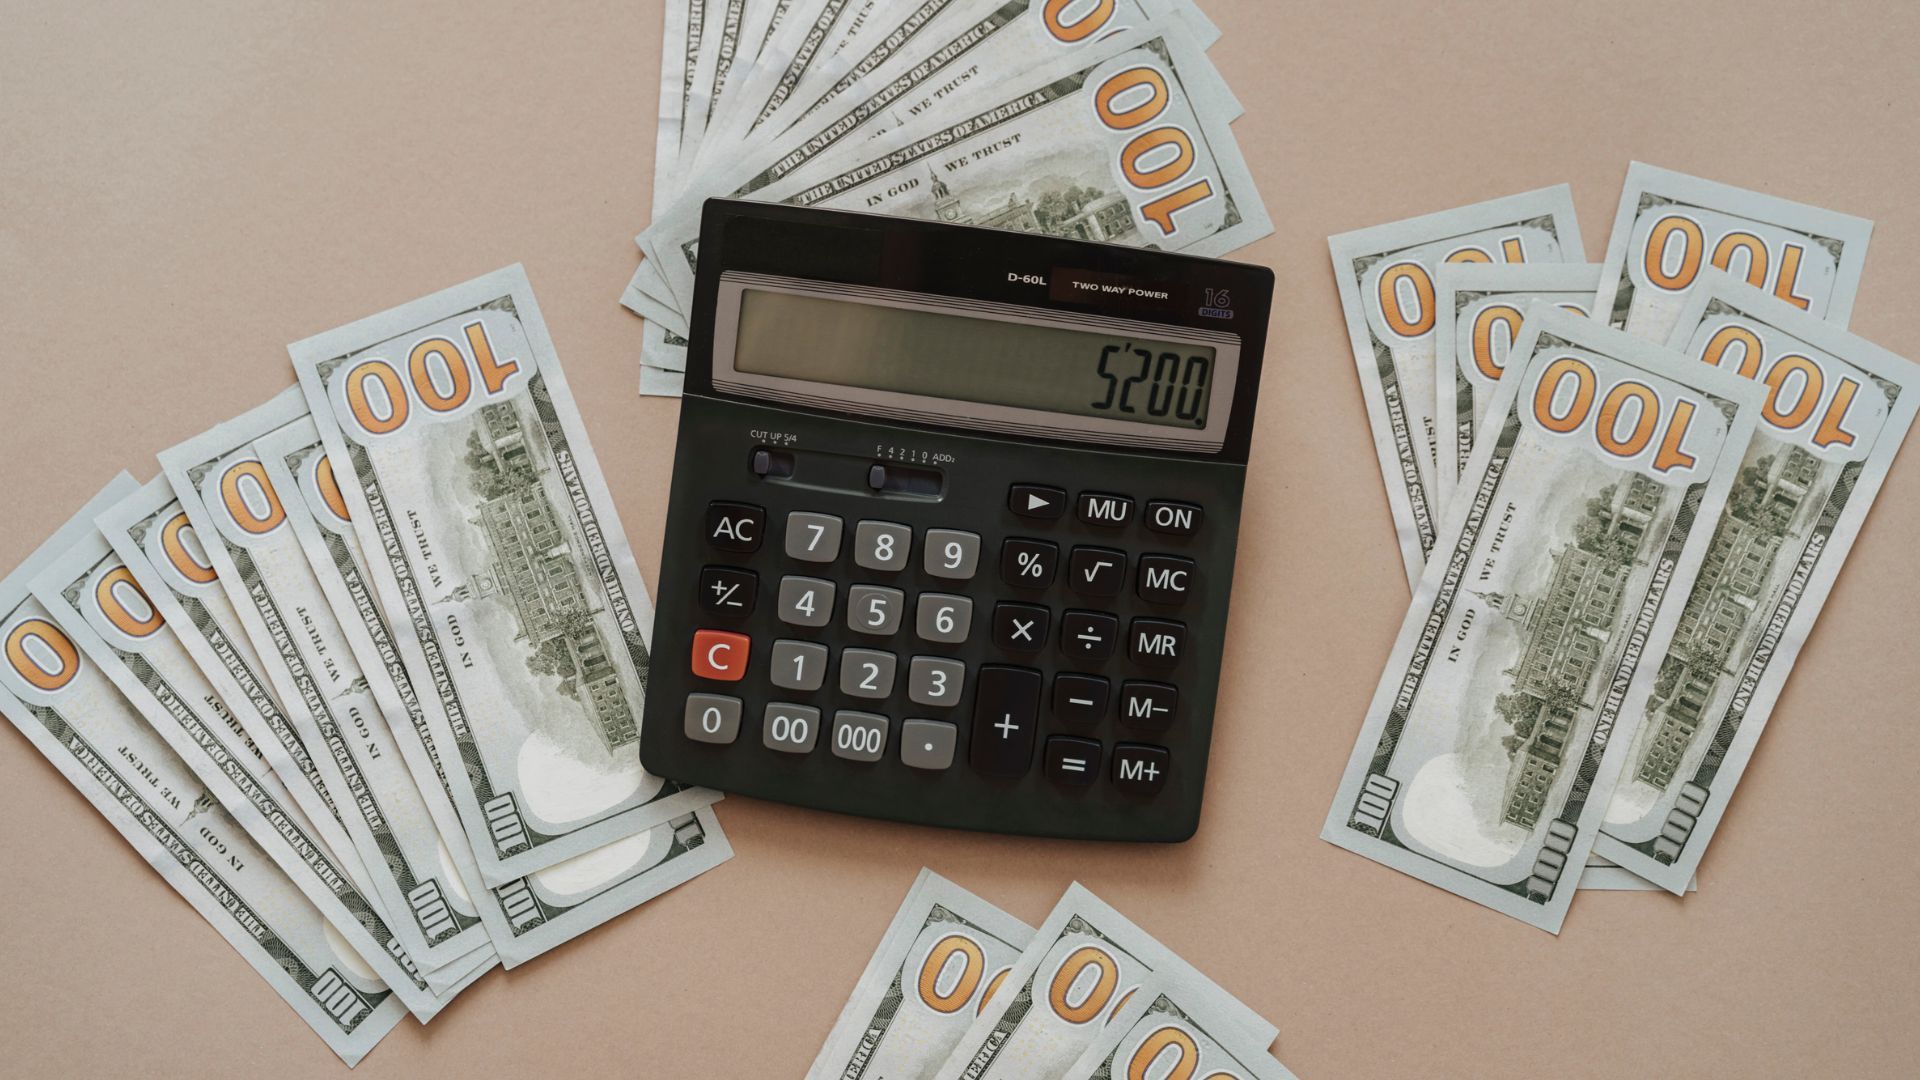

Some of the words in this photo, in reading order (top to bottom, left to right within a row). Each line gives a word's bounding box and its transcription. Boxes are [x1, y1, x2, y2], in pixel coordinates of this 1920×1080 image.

[845, 0, 875, 37] TRUS
[781, 26, 825, 87] STATES
[815, 6, 837, 31] OF
[883, 28, 907, 50] OF
[769, 148, 806, 178] THE
[801, 112, 859, 156] UNITED
[852, 74, 914, 121] STATES
[909, 61, 933, 82] OF
[926, 17, 998, 70] AMERICA
[907, 97, 933, 118] WE
[932, 63, 981, 101] TRUST
[796, 182, 833, 207] THE
[830, 155, 894, 193] UNITED
[889, 129, 953, 167] STATES
[950, 121, 974, 140] OF
[967, 88, 1048, 132] AMERICA
[1095, 66, 1214, 236] 100
[865, 192, 884, 209] IN
[886, 176, 921, 199] GOD
[943, 155, 969, 174] WE
[970, 131, 1024, 162] TRUST
[1007, 272, 1047, 286] D-60L
[1072, 281, 1099, 291] TWO
[1101, 284, 1126, 295] WAY
[1128, 288, 1169, 300] POWER
[1200, 309, 1232, 318] DIGITS
[1204, 287, 1231, 308] 16
[345, 320, 520, 435] 100
[1382, 383, 1414, 464] AMERICA
[1532, 356, 1697, 473] 100
[750, 430, 768, 440] CUT
[770, 432, 782, 441] UP
[784, 433, 797, 442] 5/4
[877, 445, 882, 453] F
[889, 446, 894, 456] 4
[900, 448, 905, 456] 2
[912, 450, 916, 458] 1
[922, 451, 928, 460] 0
[555, 449, 594, 524] DOLLARS
[1401, 461, 1419, 484] OF
[1087, 498, 1127, 521] MU
[1465, 454, 1507, 535] AMERICA
[363, 481, 402, 562] AMERICA
[404, 507, 433, 560] TRUST
[713, 516, 754, 542] AC
[1155, 506, 1193, 529] ON
[807, 524, 825, 551] 7
[874, 533, 894, 561] 8
[944, 542, 962, 569] 9
[1458, 530, 1477, 554] OF
[391, 556, 409, 580] OF
[426, 563, 444, 588] WE
[583, 521, 623, 600] HUNDRED
[1145, 567, 1187, 591] MC
[1433, 550, 1468, 616] STATES
[1445, 643, 1462, 663] IN
[1454, 606, 1477, 641] GOD
[1477, 556, 1496, 583] WE
[1489, 501, 1519, 555] TRUST
[342, 568, 388, 647] AMERICA
[399, 576, 432, 642] STATES
[612, 595, 636, 633] ONE
[795, 590, 815, 617] 4
[867, 598, 887, 626] 5
[935, 606, 955, 633] 6
[249, 583, 297, 661] AMERICA
[294, 603, 328, 656] TRUST
[445, 612, 467, 648] GOD
[1730, 676, 1757, 713] ONE
[1746, 602, 1792, 681] HUNDRED
[1781, 531, 1827, 607] DOLLARS
[375, 641, 395, 664] OF
[459, 649, 475, 669] IN
[708, 643, 731, 670] C
[1138, 632, 1176, 657] MR
[1409, 612, 1443, 675] UNITED
[1590, 707, 1615, 746] ONE
[1603, 631, 1645, 712] HUNDRED
[1633, 557, 1674, 635] DOLLARS
[207, 628, 265, 702] AMERICA
[286, 654, 306, 678] OF
[321, 657, 342, 683] WE
[422, 639, 456, 704] UNITED
[793, 655, 804, 681] 1
[859, 663, 879, 690] 2
[928, 670, 947, 697] 3
[1395, 673, 1419, 709] THE
[151, 681, 215, 750] AMERICA
[202, 690, 246, 738] TRUST
[254, 694, 276, 719] OF
[296, 674, 337, 740] STATES
[346, 704, 371, 739] GOD
[445, 700, 468, 736] THE
[702, 707, 722, 733] 0
[771, 715, 808, 743] 00
[837, 724, 881, 753] 000
[116, 742, 162, 789] TRUST
[206, 741, 230, 766] OF
[326, 734, 365, 796] UNITED
[365, 740, 382, 760] IN
[65, 735, 132, 803] AMERICA
[221, 758, 275, 816] STATES
[1119, 759, 1160, 781] M+
[122, 793, 147, 818] OF
[158, 785, 184, 811] WE
[357, 794, 383, 830] THE
[1353, 772, 1399, 833] 100
[138, 810, 195, 866] STATES
[197, 824, 229, 856] GOD
[266, 808, 320, 865] UNITED
[484, 792, 530, 852] 100
[226, 853, 245, 872] IN
[312, 858, 345, 892] THE
[186, 858, 242, 915] UNITED
[234, 906, 267, 940] THE
[408, 878, 461, 940] 100
[310, 967, 372, 1026] 100
